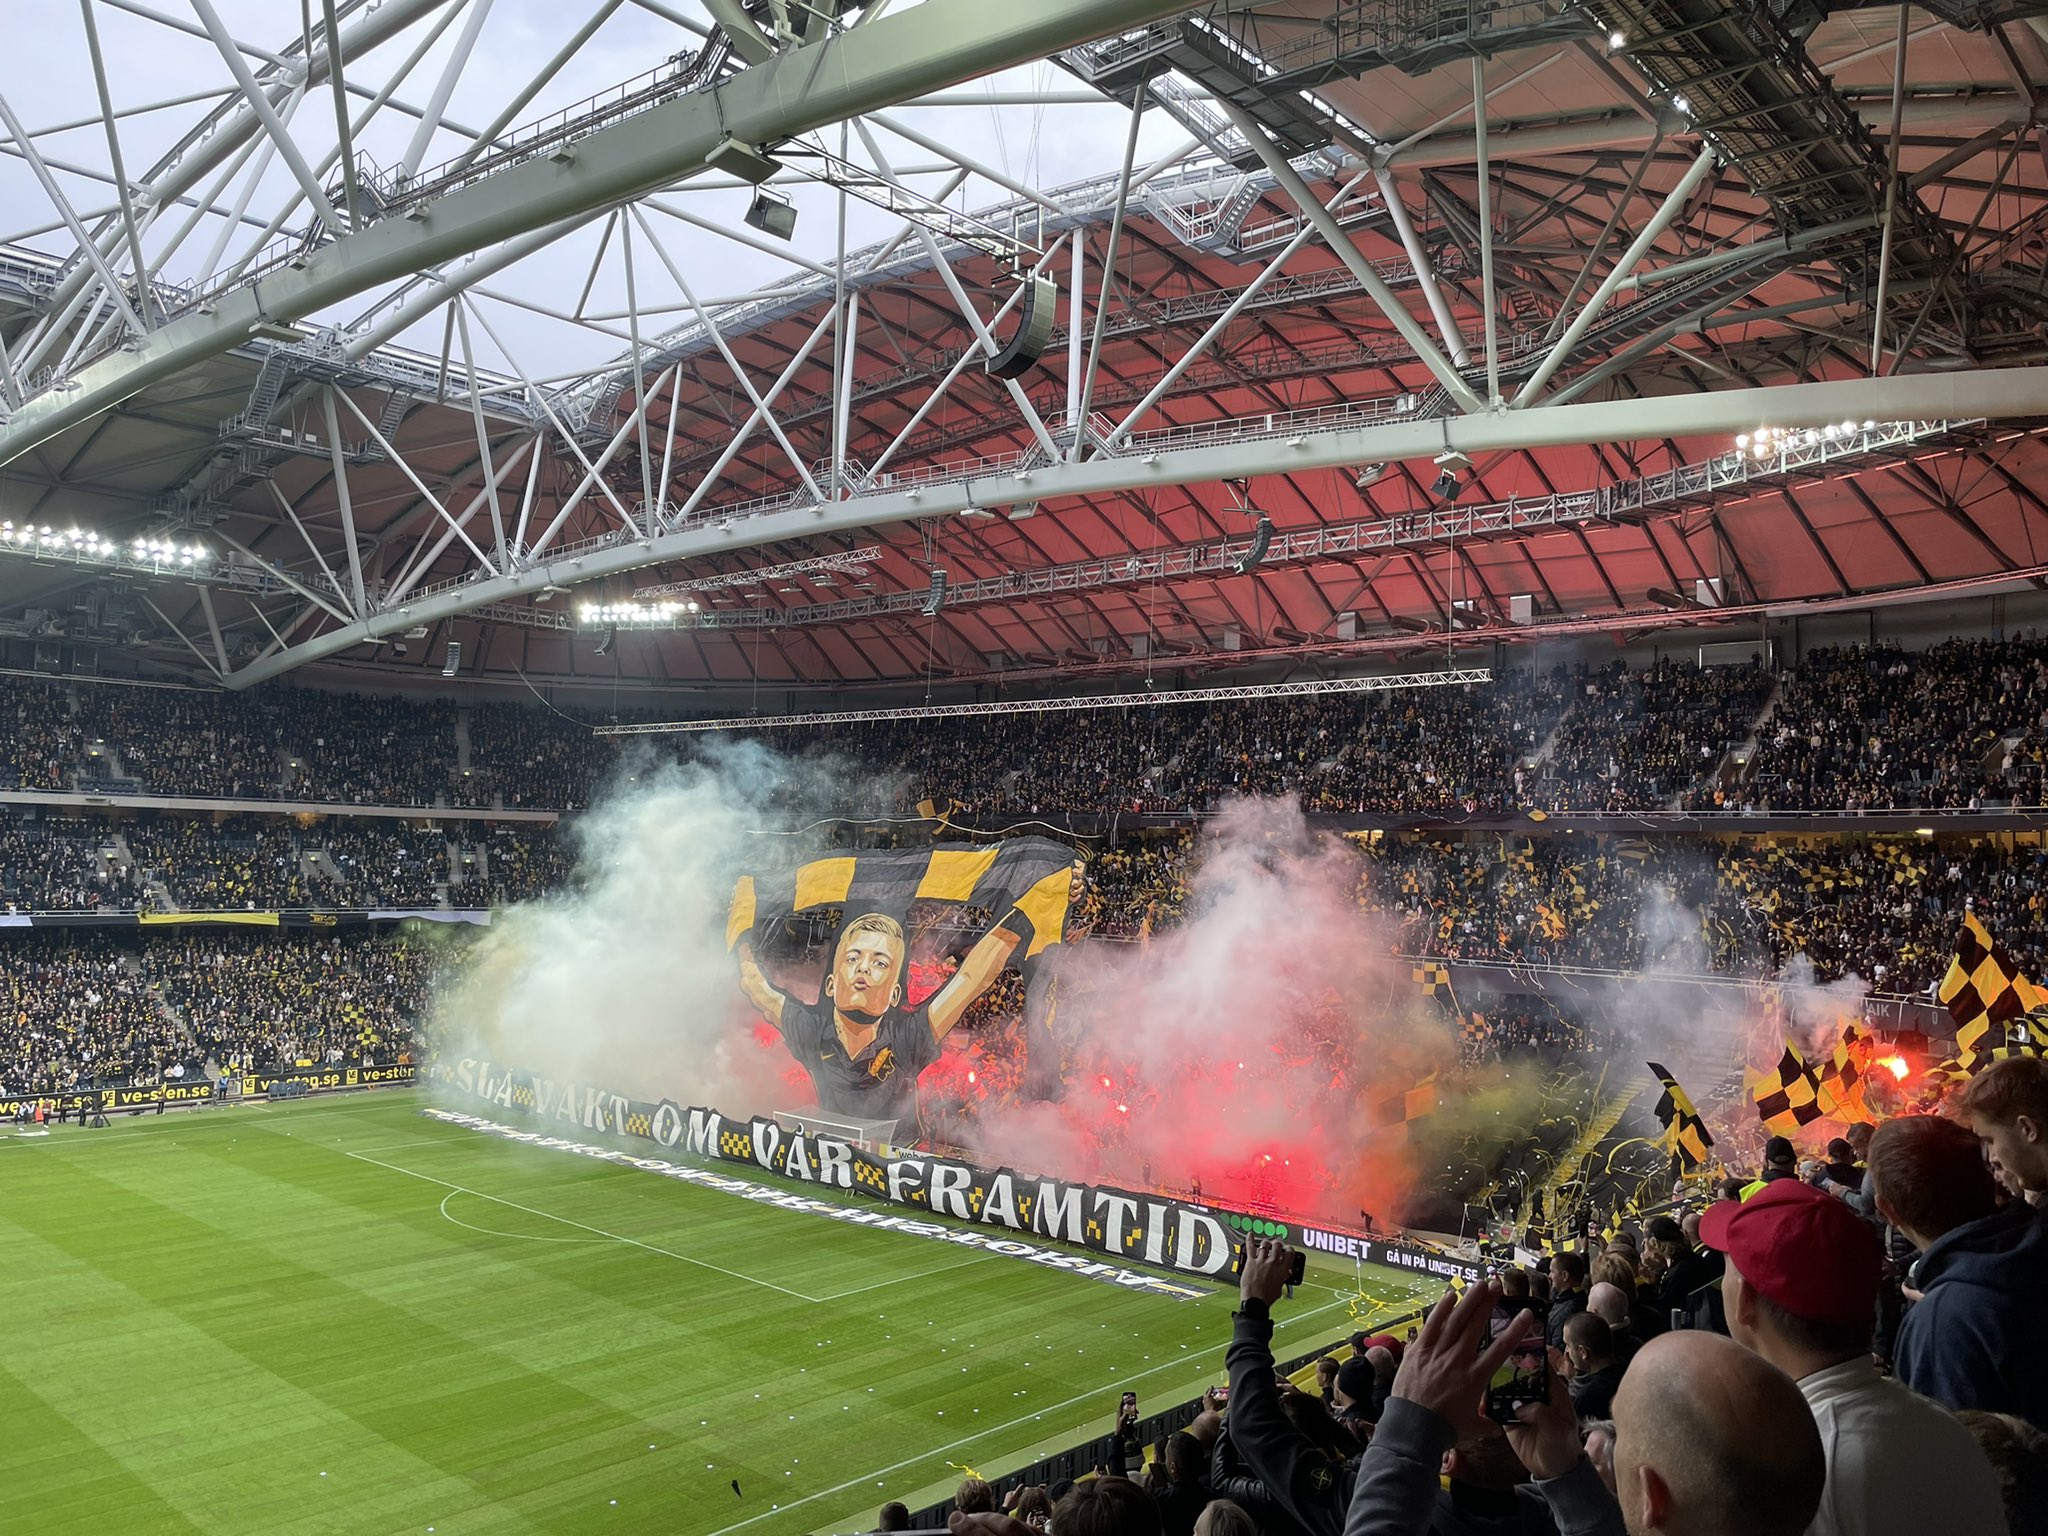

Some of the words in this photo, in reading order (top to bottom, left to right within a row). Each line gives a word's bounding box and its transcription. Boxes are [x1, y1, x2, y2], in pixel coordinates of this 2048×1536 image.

[1868, 1004, 1889, 1018] AIK
[122, 1085, 210, 1103] ve-sen.se
[456, 1057, 513, 1108] SLÅ
[532, 1077, 630, 1136] VAKT
[652, 1103, 722, 1158] OM
[752, 1121, 853, 1188] VÅR
[887, 1159, 1230, 1275] FRAMTID
[1303, 1228, 1371, 1259] UNIBET
[1386, 1248, 1400, 1264] GÅ
[1402, 1253, 1411, 1267] IN
[1413, 1254, 1426, 1268] PÅ
